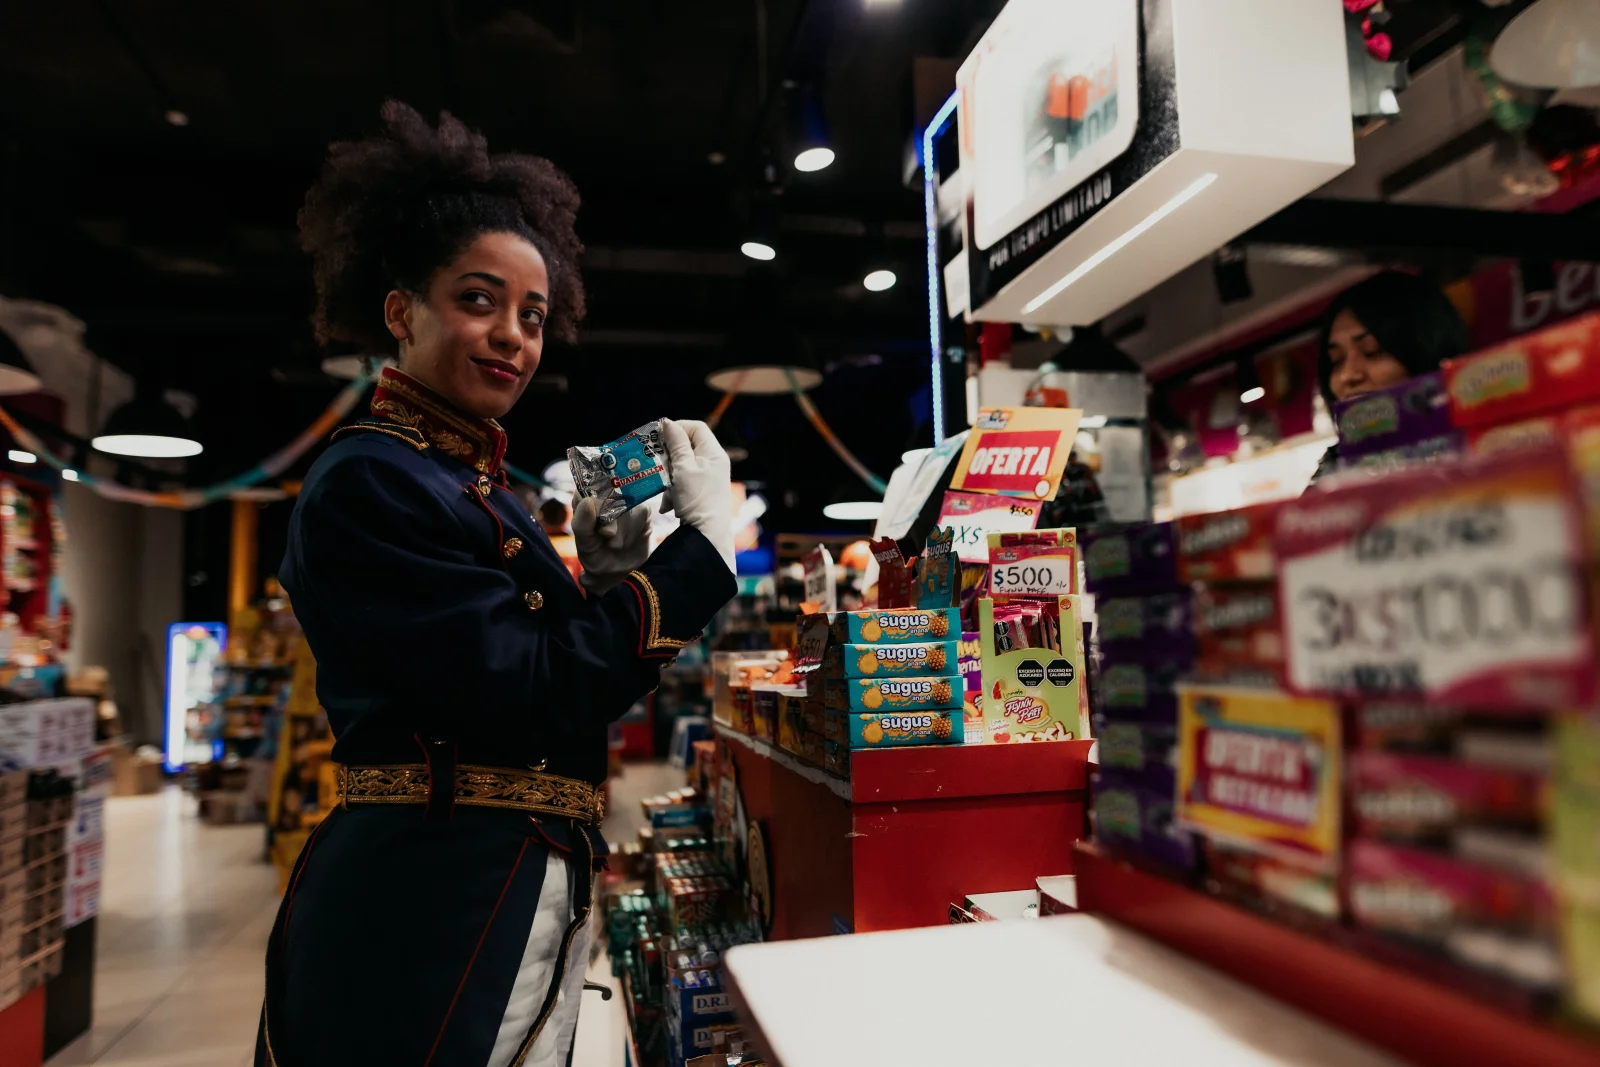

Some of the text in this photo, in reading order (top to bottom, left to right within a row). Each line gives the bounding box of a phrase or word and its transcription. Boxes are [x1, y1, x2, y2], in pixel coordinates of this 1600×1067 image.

[968, 446, 1052, 475] OFERTA
[1009, 504, 1033, 517] $550
[927, 541, 951, 559] sugus
[993, 566, 1052, 586] $500
[879, 614, 930, 629] sugus
[876, 647, 927, 662] sugus
[880, 680, 932, 696] sugus
[881, 716, 933, 731] sugus
